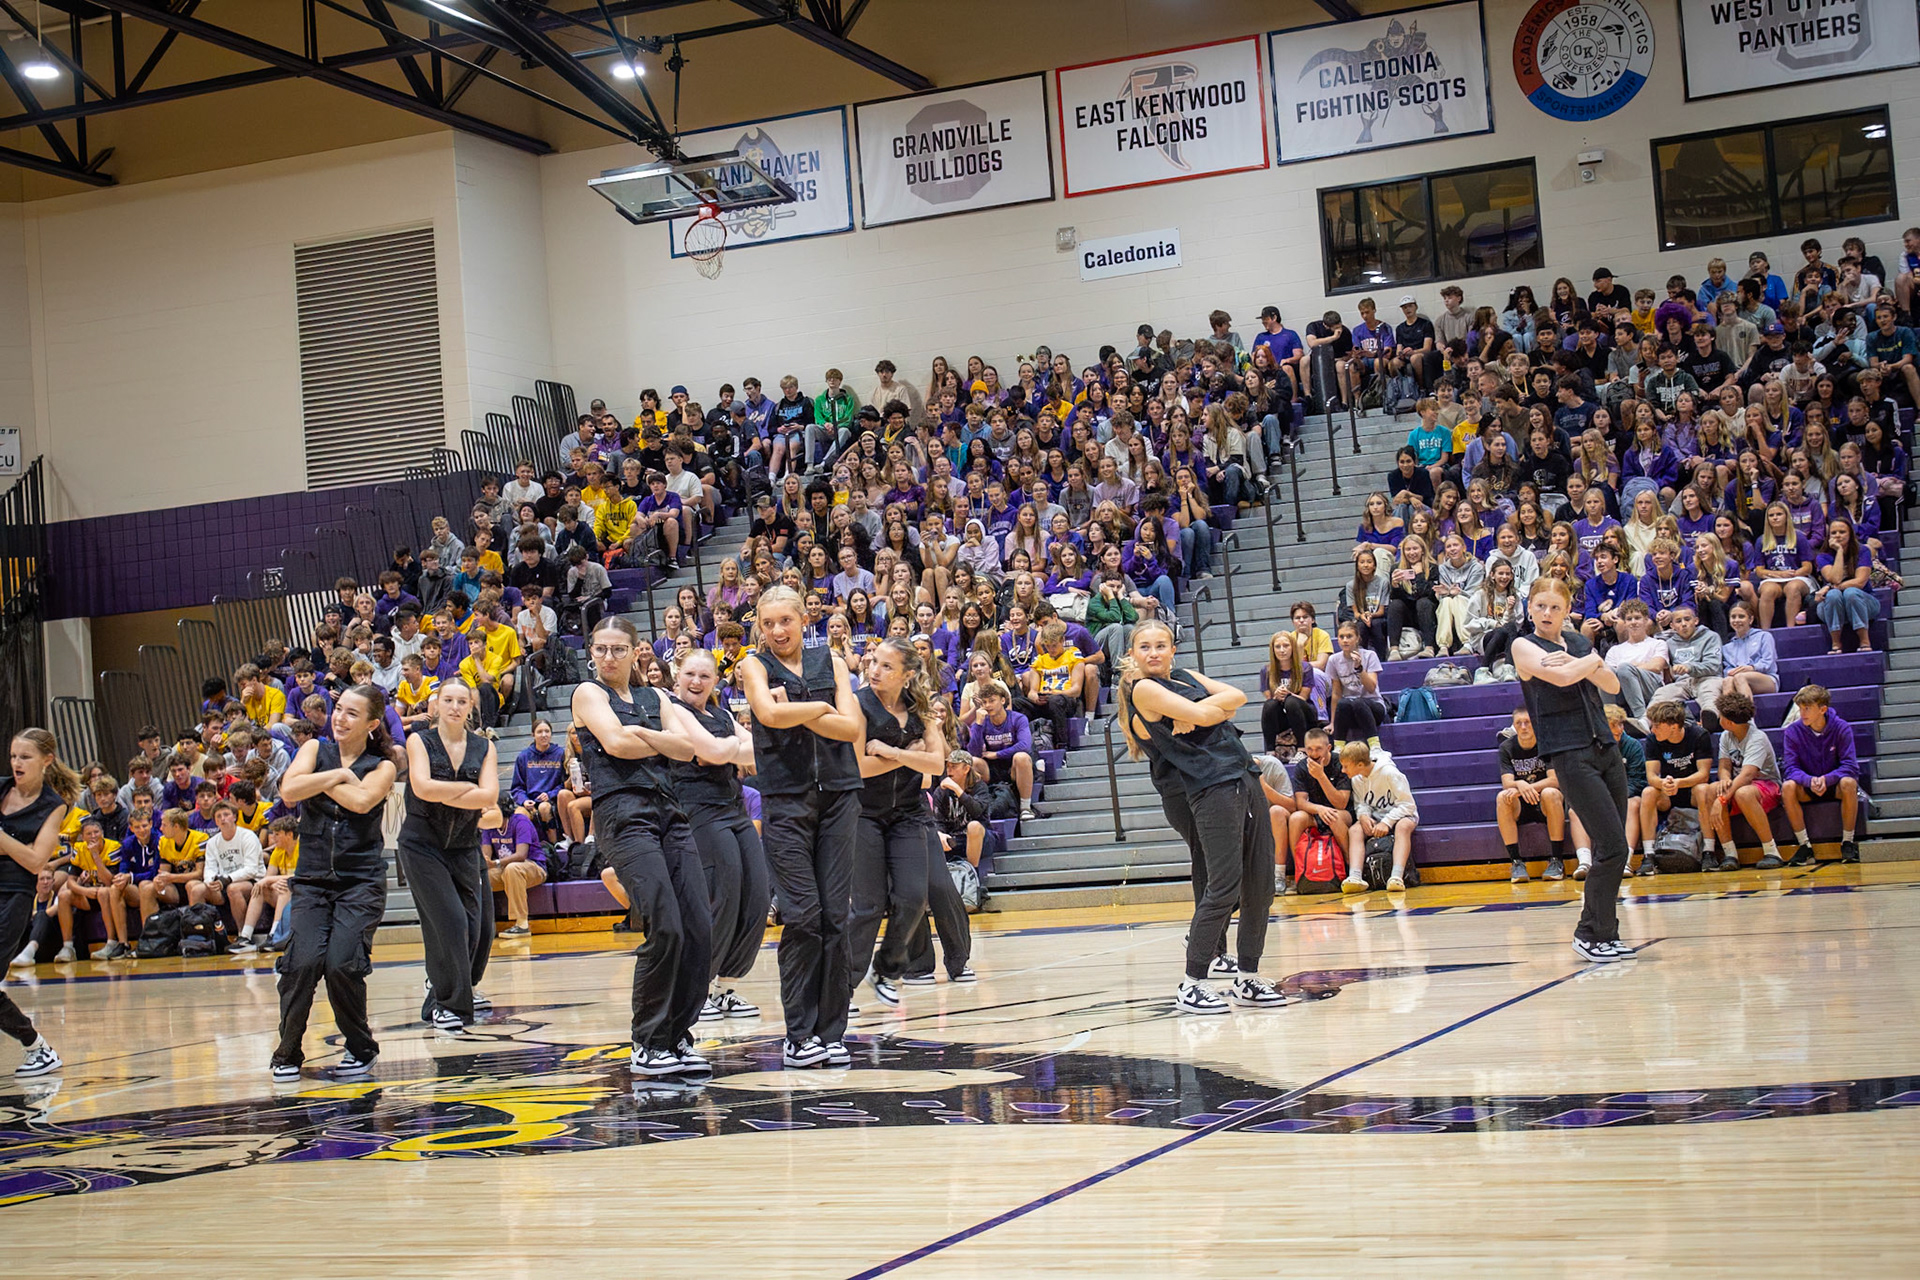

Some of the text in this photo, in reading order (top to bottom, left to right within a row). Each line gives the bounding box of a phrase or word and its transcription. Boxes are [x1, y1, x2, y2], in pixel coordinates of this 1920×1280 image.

[1564, 14, 1598, 30] 1958
[1606, 0, 1649, 55] HLETICS
[1711, 0, 1773, 25] WEST
[1520, 0, 1565, 76] ACADEMICS
[1573, 29, 1591, 39] THE
[1739, 13, 1861, 52] PANTHERS
[1562, 39, 1606, 74] CONFERENCE
[1573, 45, 1594, 59] OK
[1319, 51, 1437, 89] CALEDONIA
[1075, 80, 1246, 129] EAST KENTWOOD
[1296, 77, 1466, 123] FIGHTING SCOTS
[1536, 76, 1637, 116] SPORTSMANSHIP
[893, 118, 1012, 158] GRANDVILLE
[1117, 116, 1207, 151] FALCONS
[761, 150, 821, 178] HAVEN
[906, 150, 1003, 185] BULLDOGS
[1084, 240, 1176, 269] Caledonia
[1582, 539, 1603, 548] SCO
